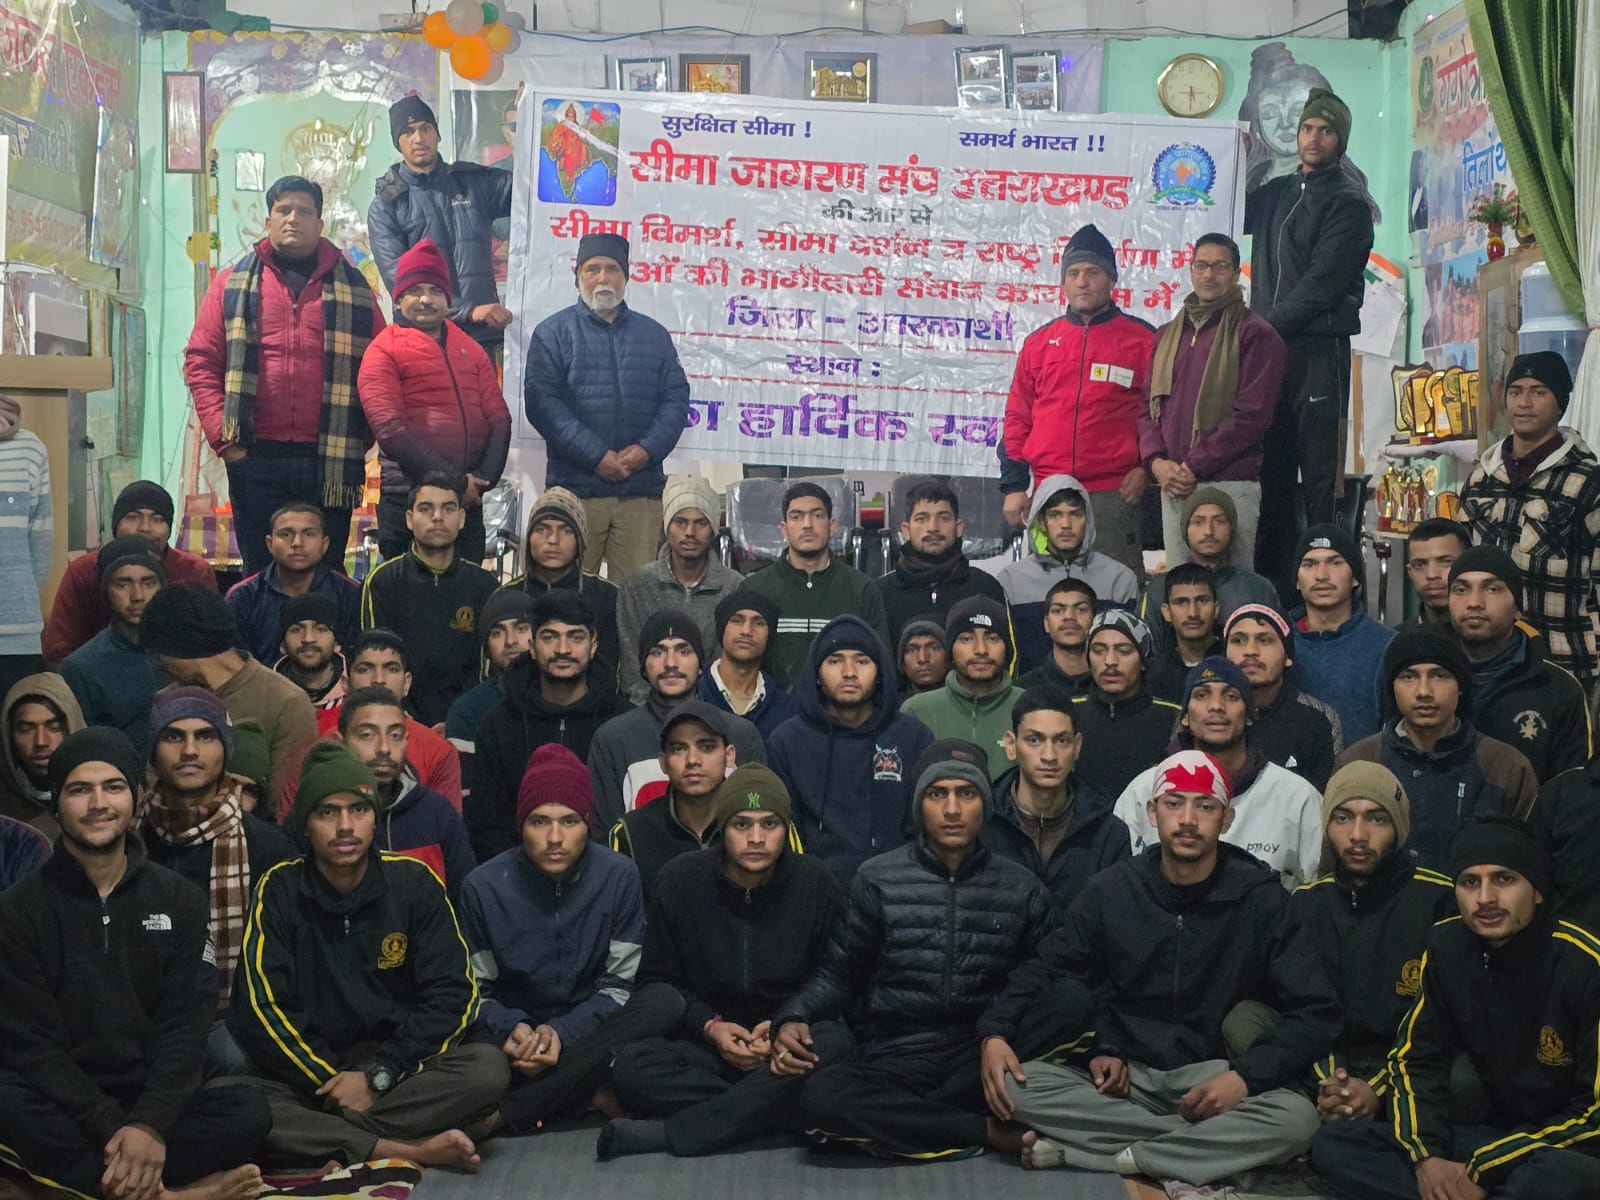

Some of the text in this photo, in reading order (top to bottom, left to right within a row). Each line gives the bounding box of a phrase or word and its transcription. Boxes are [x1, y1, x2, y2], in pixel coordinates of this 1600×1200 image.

[661, 112, 812, 139] सुरक्षित सीमा !
[958, 128, 1106, 152] समर्थ भारत !!
[629, 137, 720, 186] सीमा
[728, 156, 870, 194] जागरण
[550, 208, 632, 241] सीमा
[822, 198, 855, 221] की
[910, 204, 934, 225] से
[685, 256, 730, 288] की
[737, 392, 915, 443] हार्दिक
